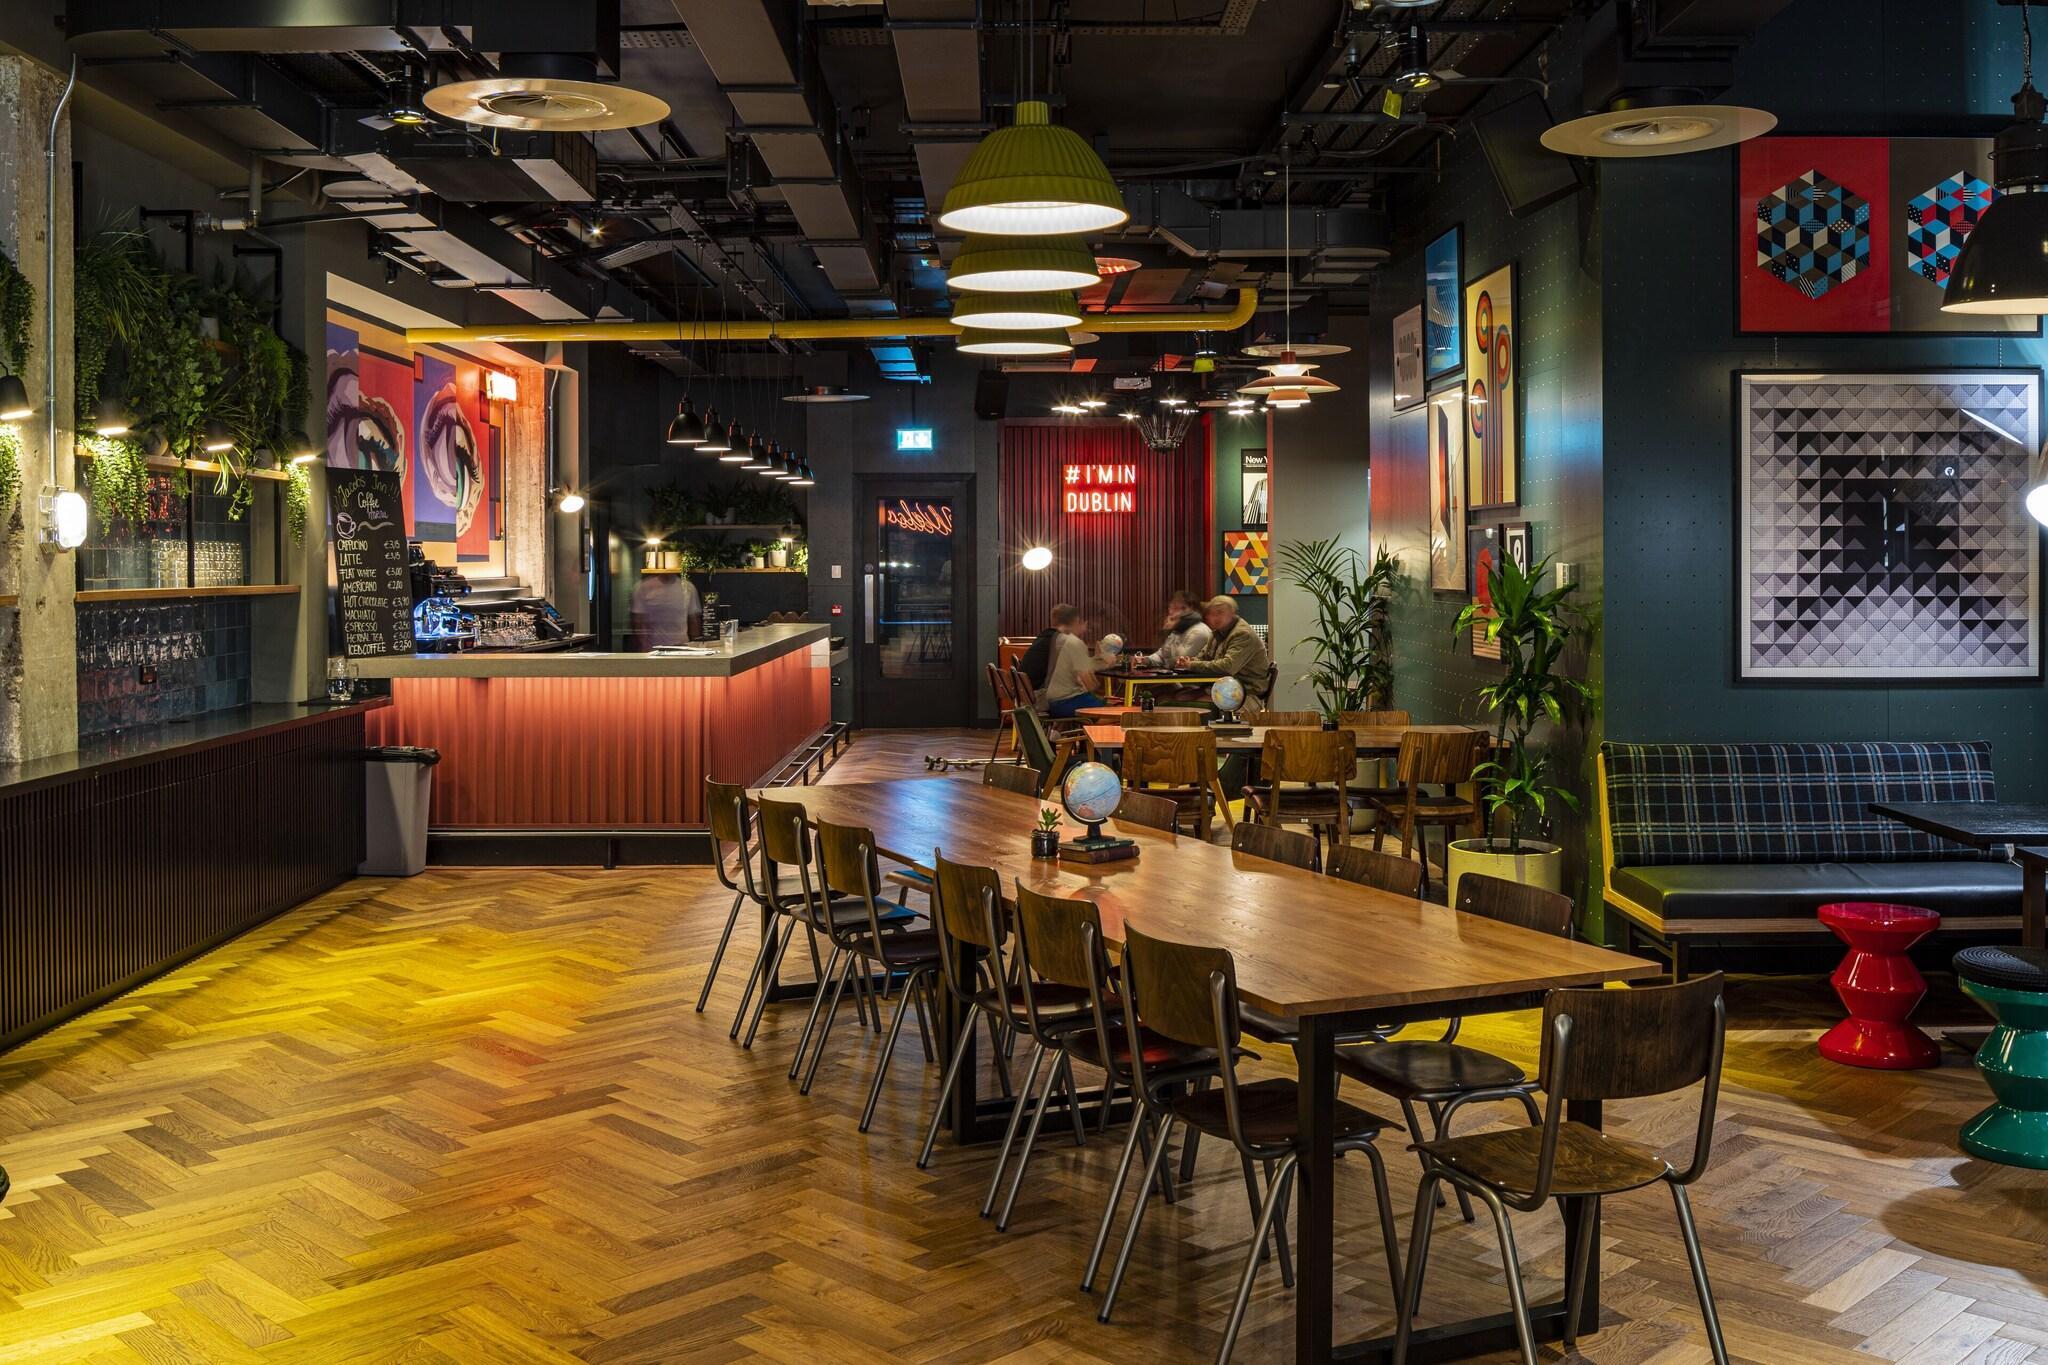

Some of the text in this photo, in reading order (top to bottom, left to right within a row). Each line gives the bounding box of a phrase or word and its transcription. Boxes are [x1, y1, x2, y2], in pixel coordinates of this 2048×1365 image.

[1245, 455, 1263, 464] New
[1118, 464, 1136, 484] IN
[357, 491, 380, 512] Coffee
[1067, 491, 1132, 512] DUBLIN
[339, 552, 363, 566] LATTE
[343, 595, 358, 608] HOT
[344, 621, 378, 633] ESPRESSO
[372, 632, 384, 642] TEA
